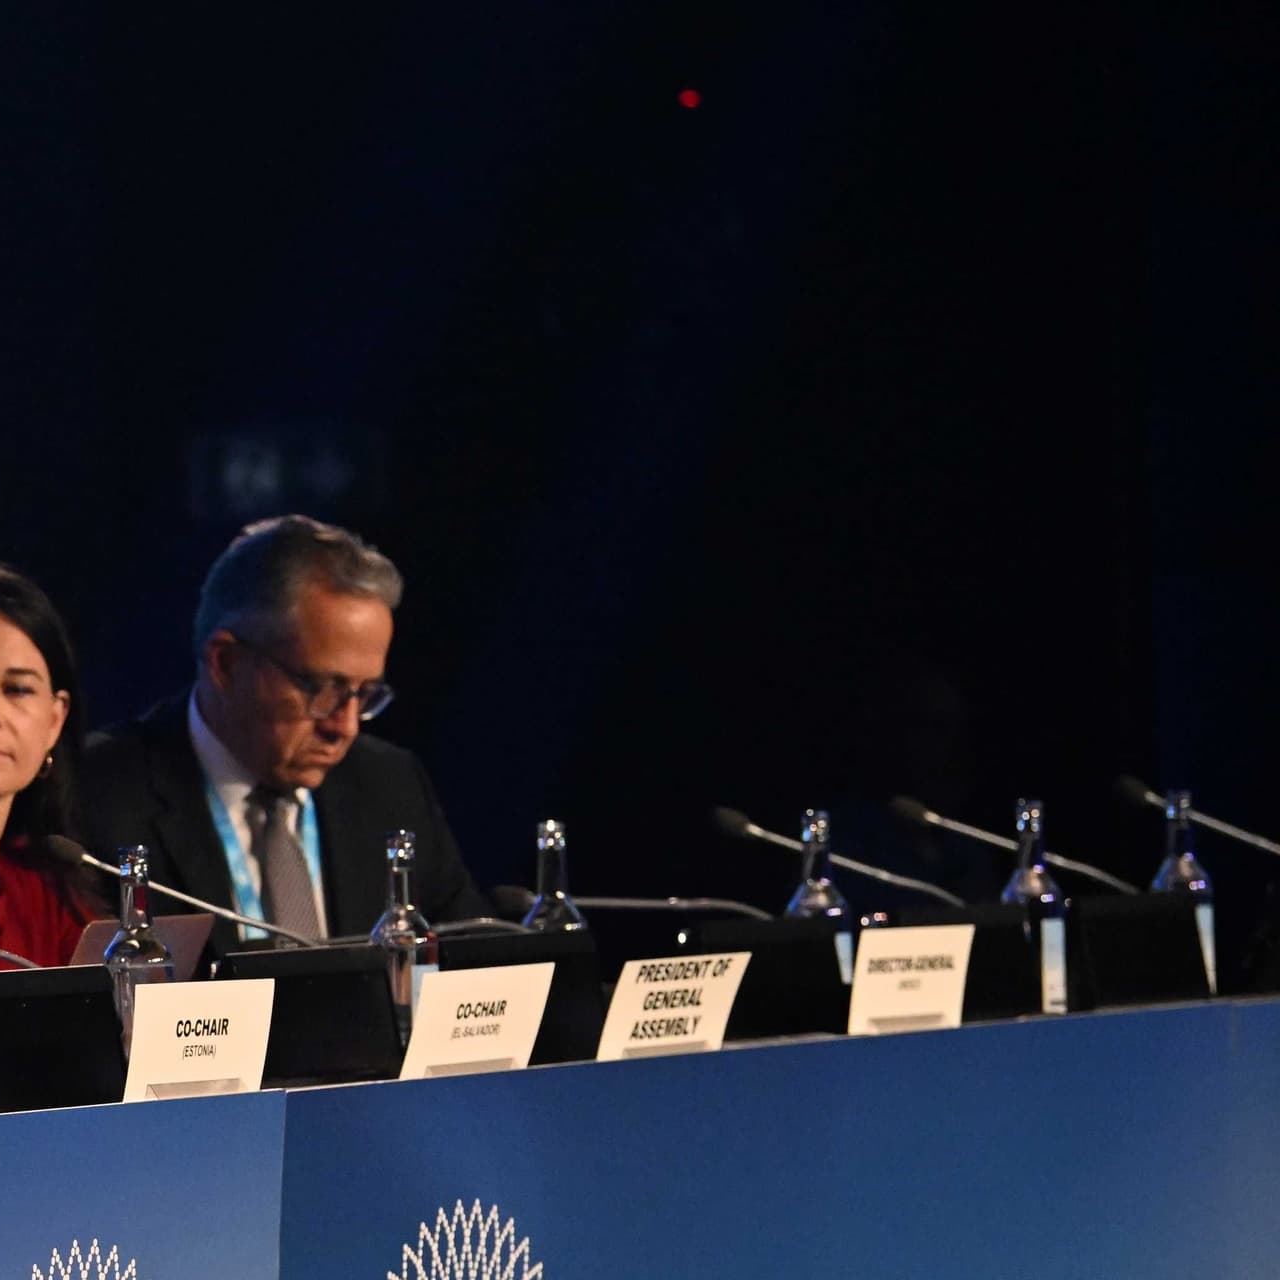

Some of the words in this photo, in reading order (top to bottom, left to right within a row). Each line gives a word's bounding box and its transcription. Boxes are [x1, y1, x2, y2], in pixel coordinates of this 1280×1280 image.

[636, 960, 711, 984] PRESIDENT
[713, 958, 733, 977] OF
[456, 1000, 507, 1020] CO-CHAIR
[643, 988, 703, 1011] GENERAL
[176, 1018, 229, 1038] CO-CHAIR
[630, 1015, 701, 1040] ASSEMBLY
[182, 1044, 216, 1060] (ESTONIA)
